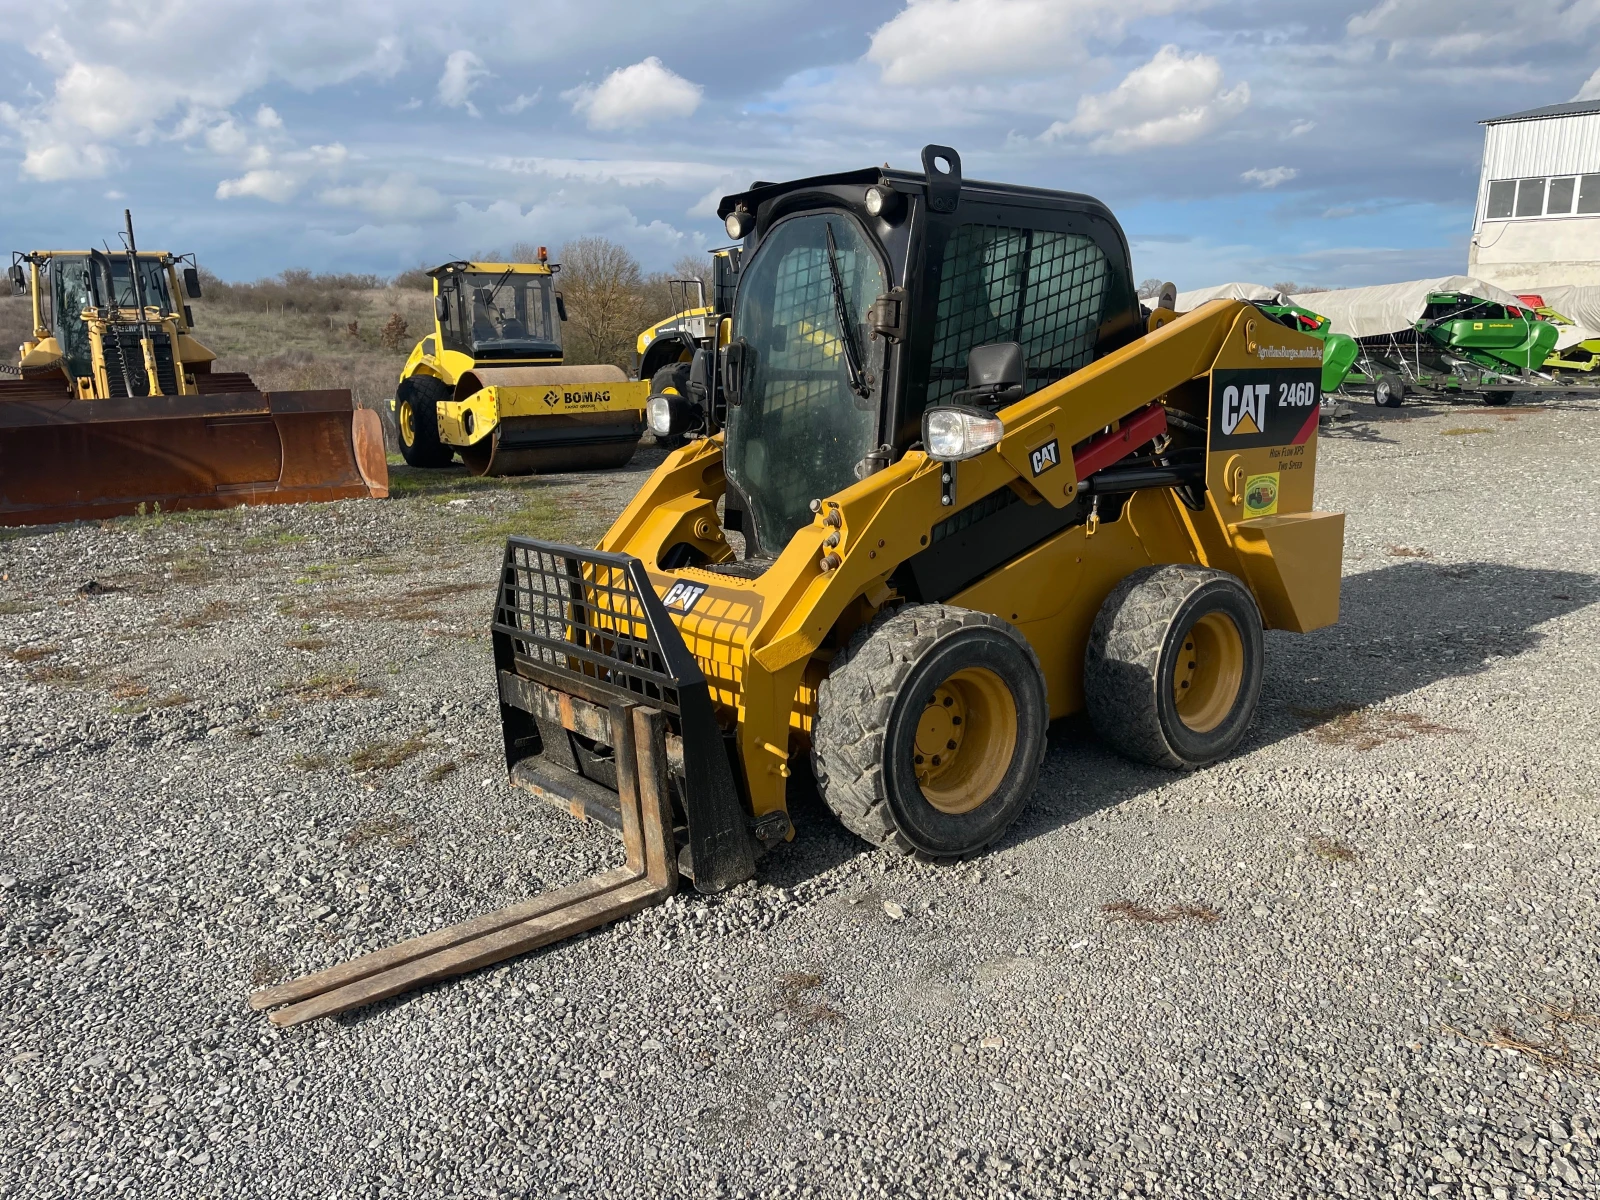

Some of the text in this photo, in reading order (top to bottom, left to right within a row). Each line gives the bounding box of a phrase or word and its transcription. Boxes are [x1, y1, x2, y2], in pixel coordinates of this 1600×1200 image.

[564, 391, 611, 404] BOMAG
[1221, 382, 1315, 436] CAT 246D
[1032, 442, 1057, 473] CAT
[1294, 445, 1305, 456] XPS
[663, 583, 705, 612] CAT
